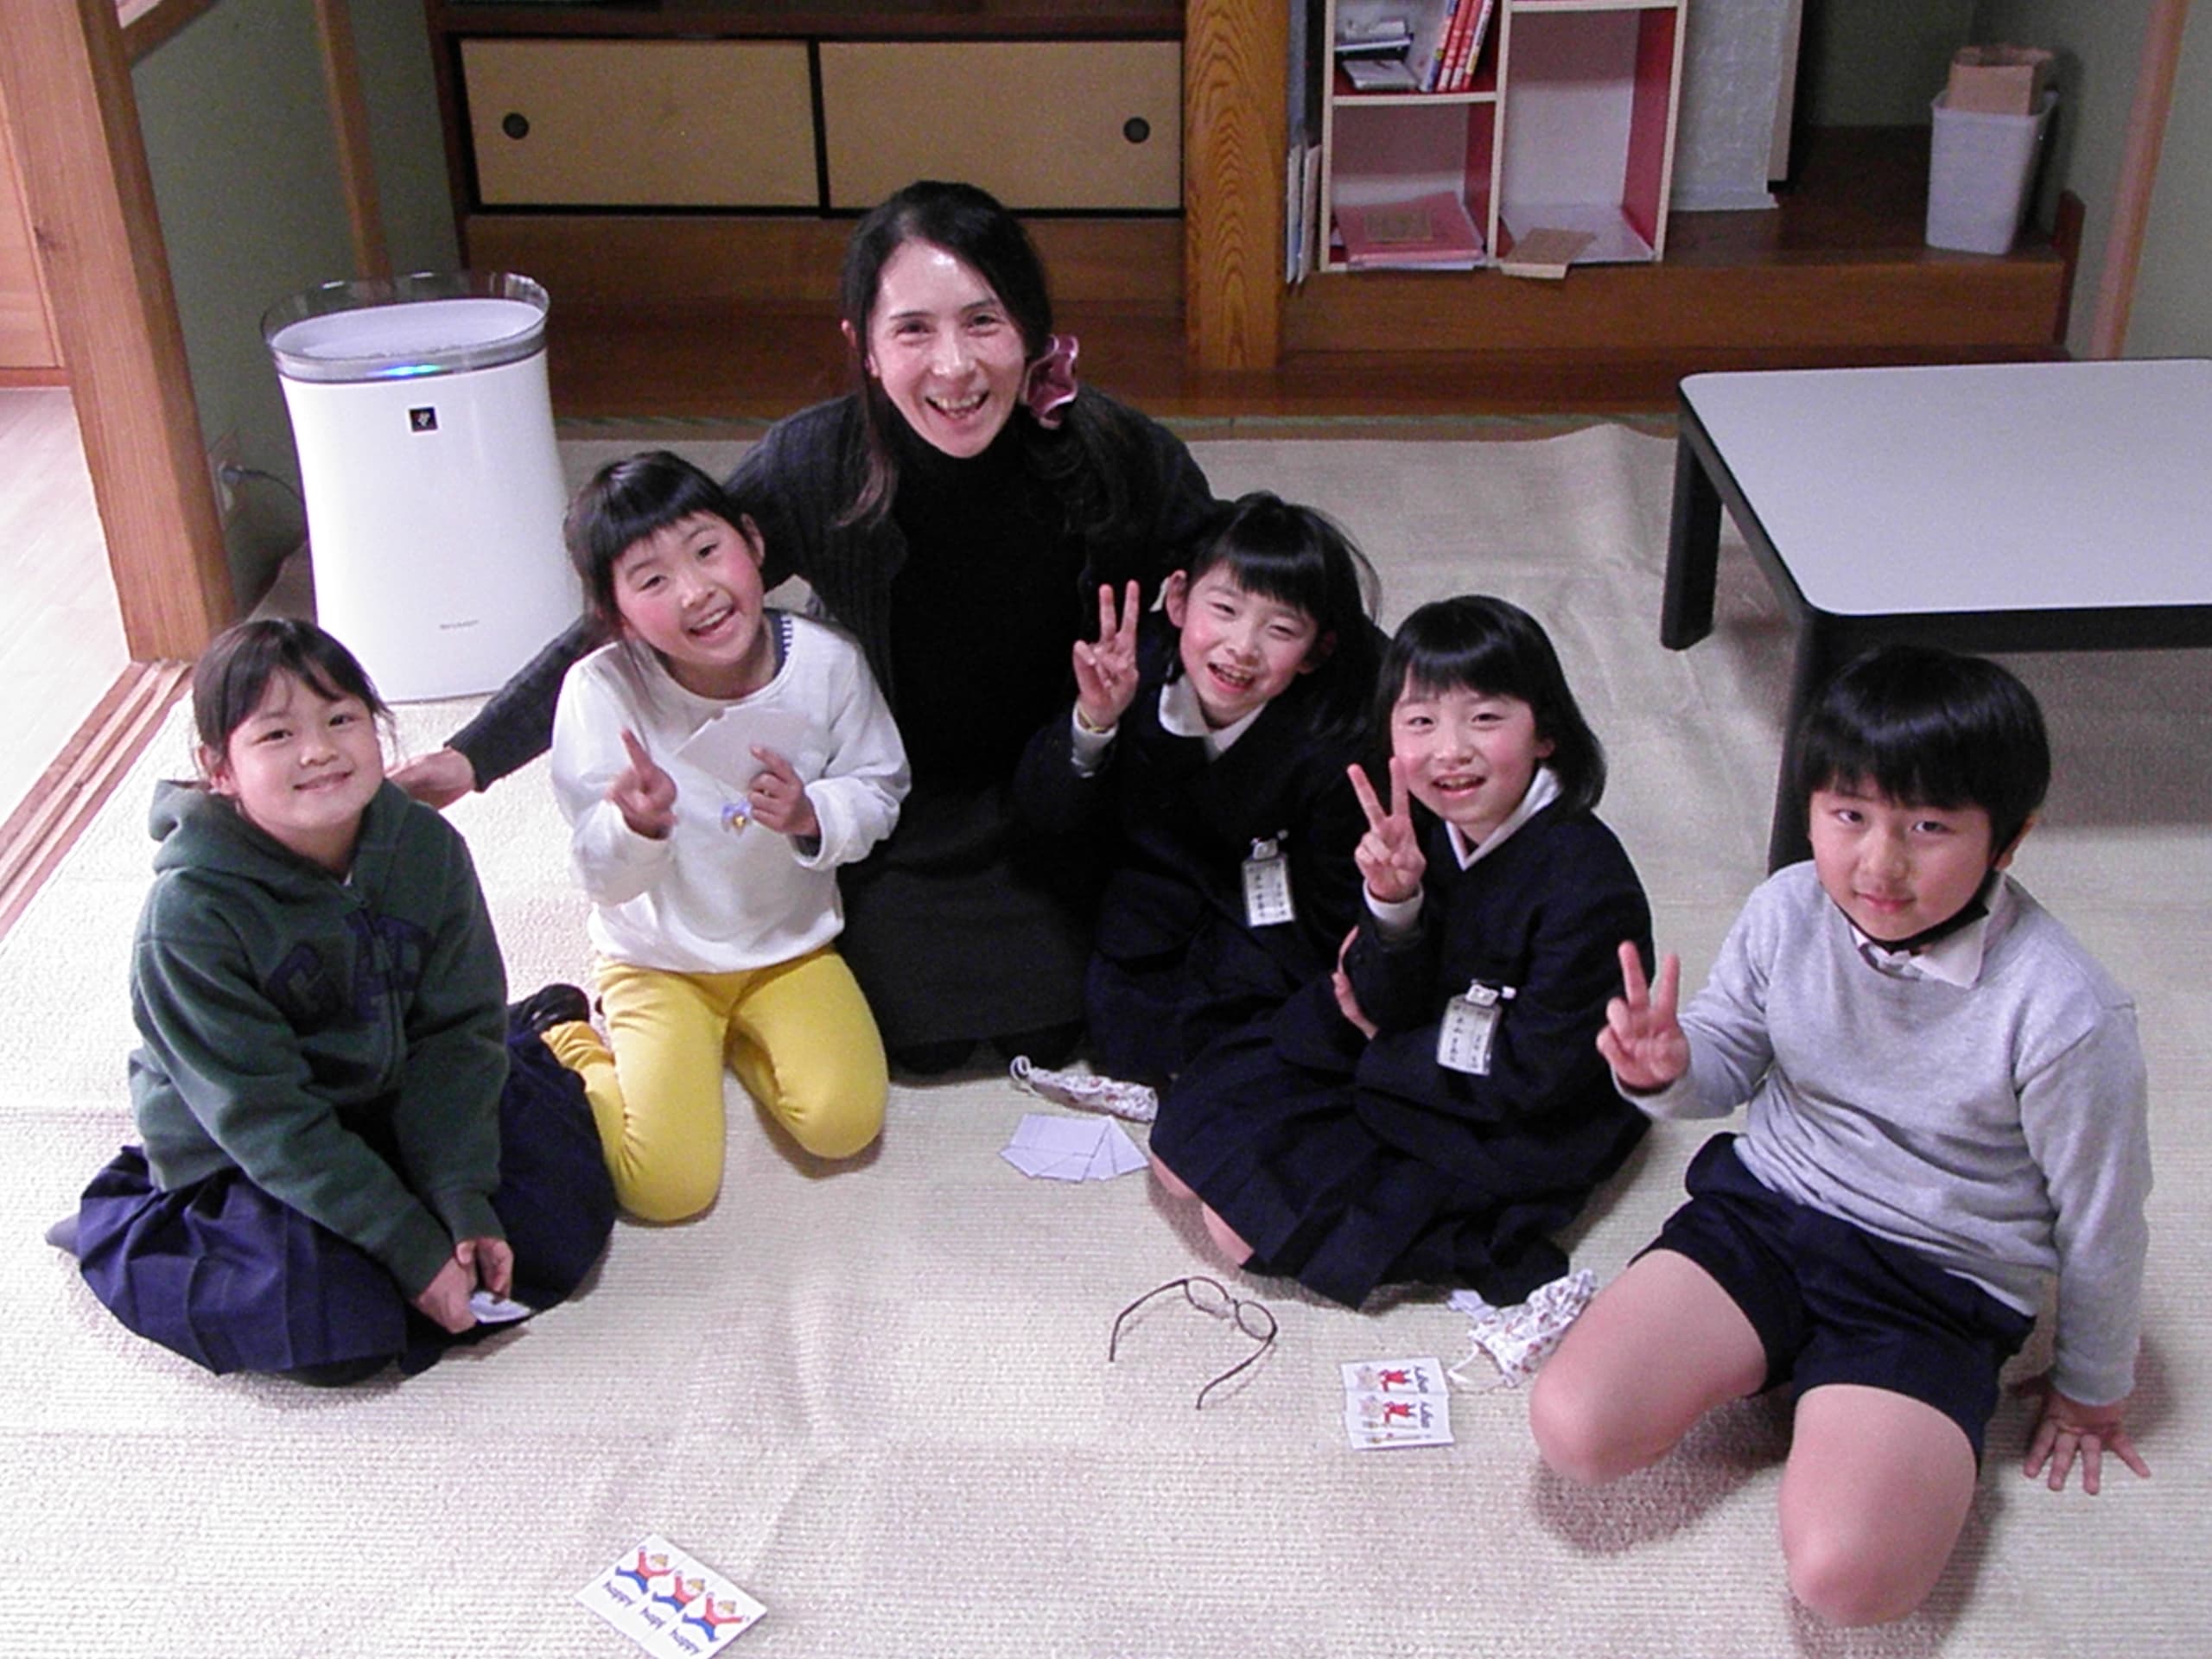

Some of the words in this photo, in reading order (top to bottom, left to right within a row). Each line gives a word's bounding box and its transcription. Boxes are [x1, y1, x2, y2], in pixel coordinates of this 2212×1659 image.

[603, 1580, 634, 1607] happy
[639, 1606, 665, 1630] happ
[670, 1629, 701, 1655] happy
